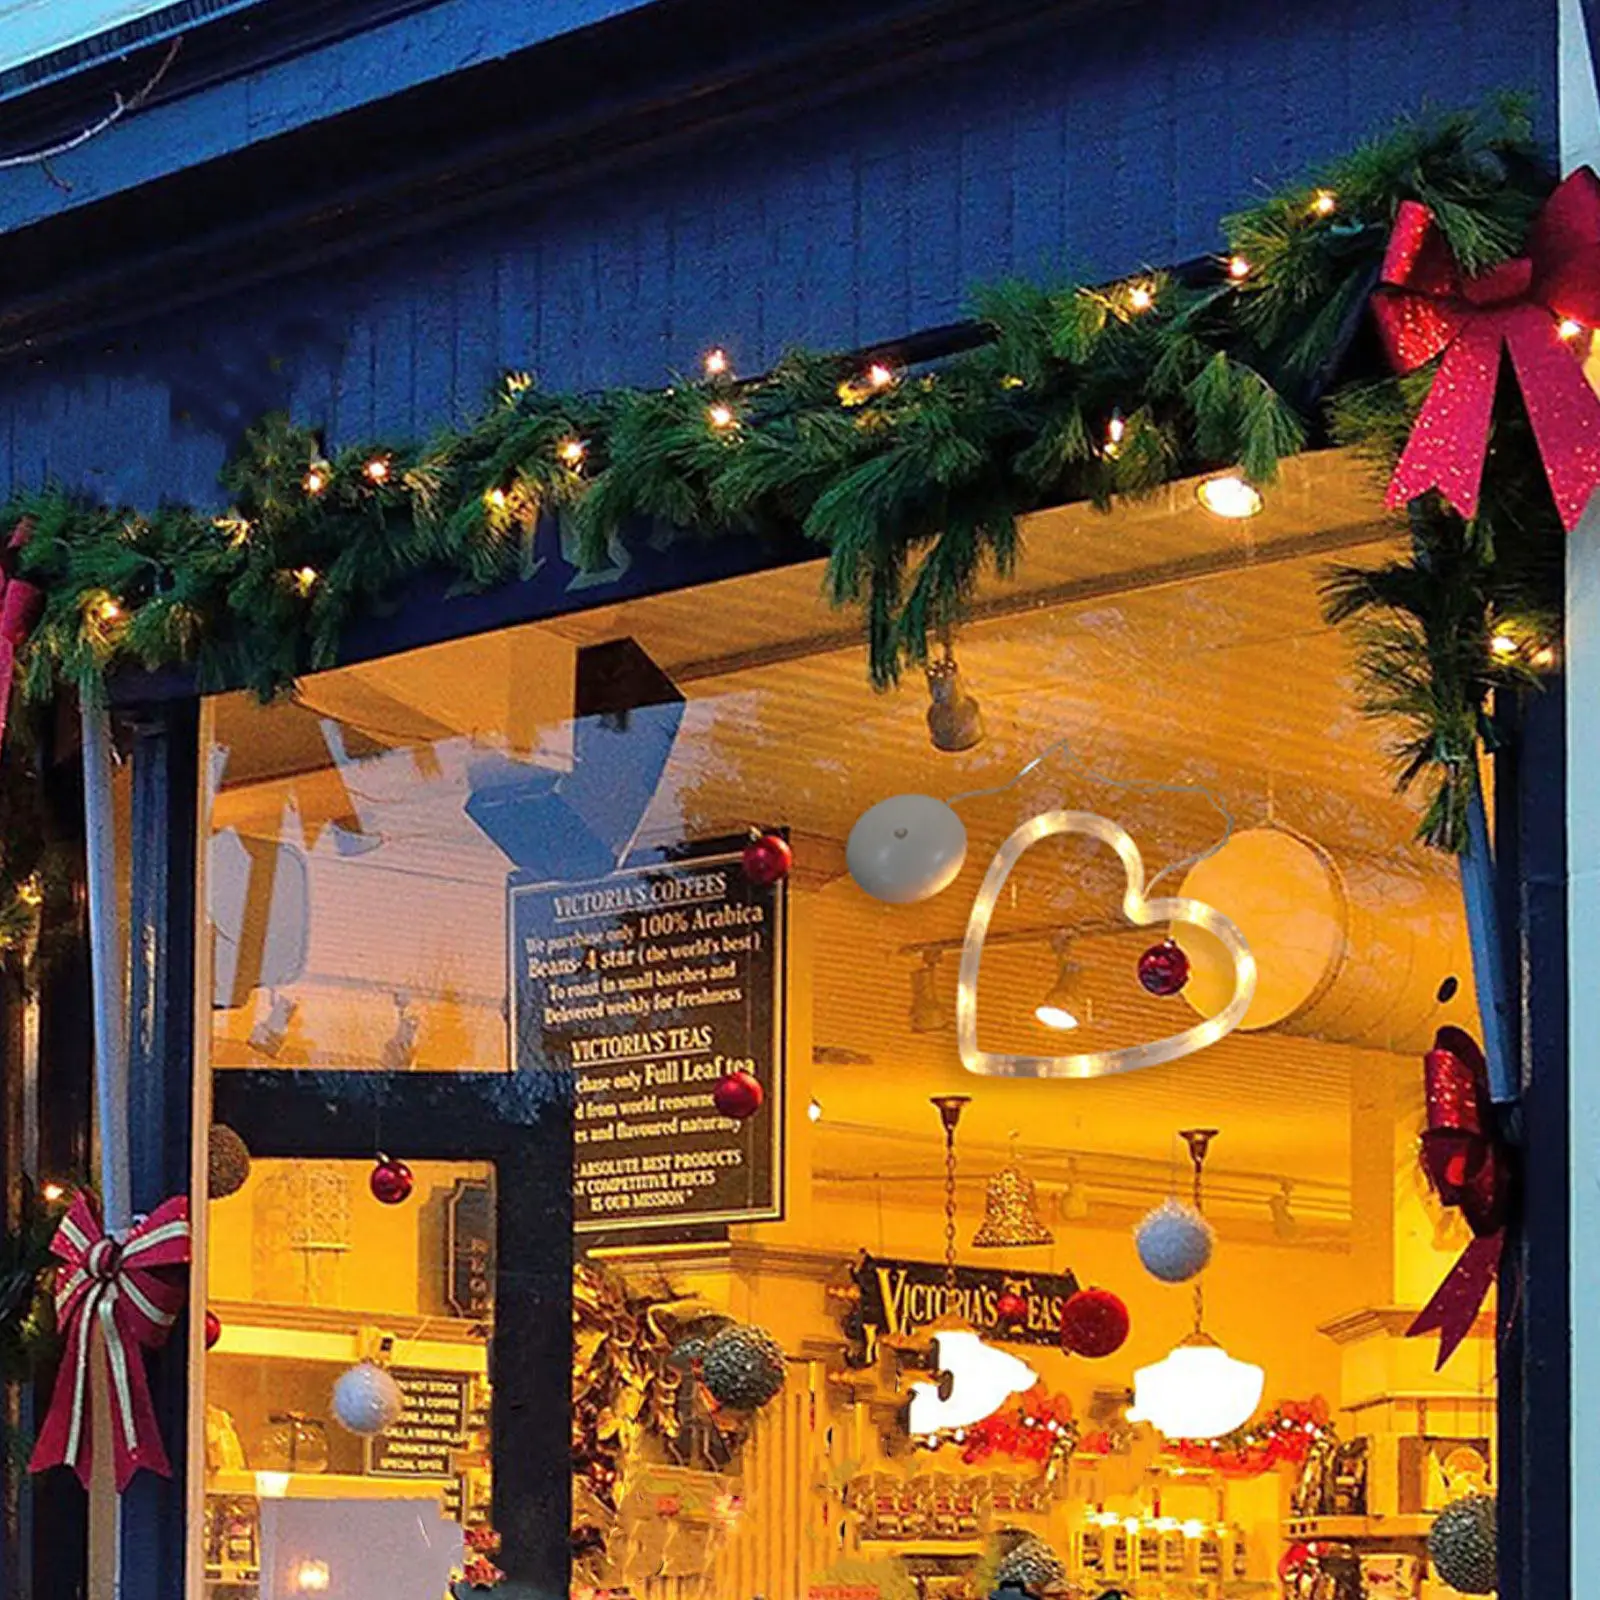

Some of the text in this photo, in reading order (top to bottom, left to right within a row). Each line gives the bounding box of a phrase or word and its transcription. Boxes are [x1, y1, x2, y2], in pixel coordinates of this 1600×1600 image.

[639, 911, 689, 938] 100%
[692, 903, 764, 931] Arabica
[585, 949, 598, 970] 4
[600, 949, 636, 969] star
[670, 939, 720, 959] world's
[567, 981, 600, 998] roast
[602, 977, 616, 993] in
[618, 971, 653, 991] small
[655, 966, 708, 986] batches
[709, 961, 737, 979] and
[544, 987, 742, 1024] Delivered weekly for freshness
[572, 1026, 713, 1061] VICTORIA'S TEAS
[613, 1070, 641, 1092] only
[644, 1060, 679, 1086] Full
[682, 1055, 725, 1081] Leaf
[726, 1056, 756, 1076] tea
[586, 1102, 617, 1118] from
[619, 1095, 657, 1115] world
[590, 1122, 614, 1140] and
[616, 1116, 678, 1139] flavoured
[580, 1158, 639, 1176] ABSOLUTE
[641, 1155, 671, 1171] BEST
[674, 1149, 743, 1169] PRODUCTS
[587, 1174, 669, 1194] COMPETITIVE
[671, 1169, 716, 1188] PRICES
[605, 1194, 630, 1210] OUR
[876, 1267, 999, 1335] VICTORIA'S
